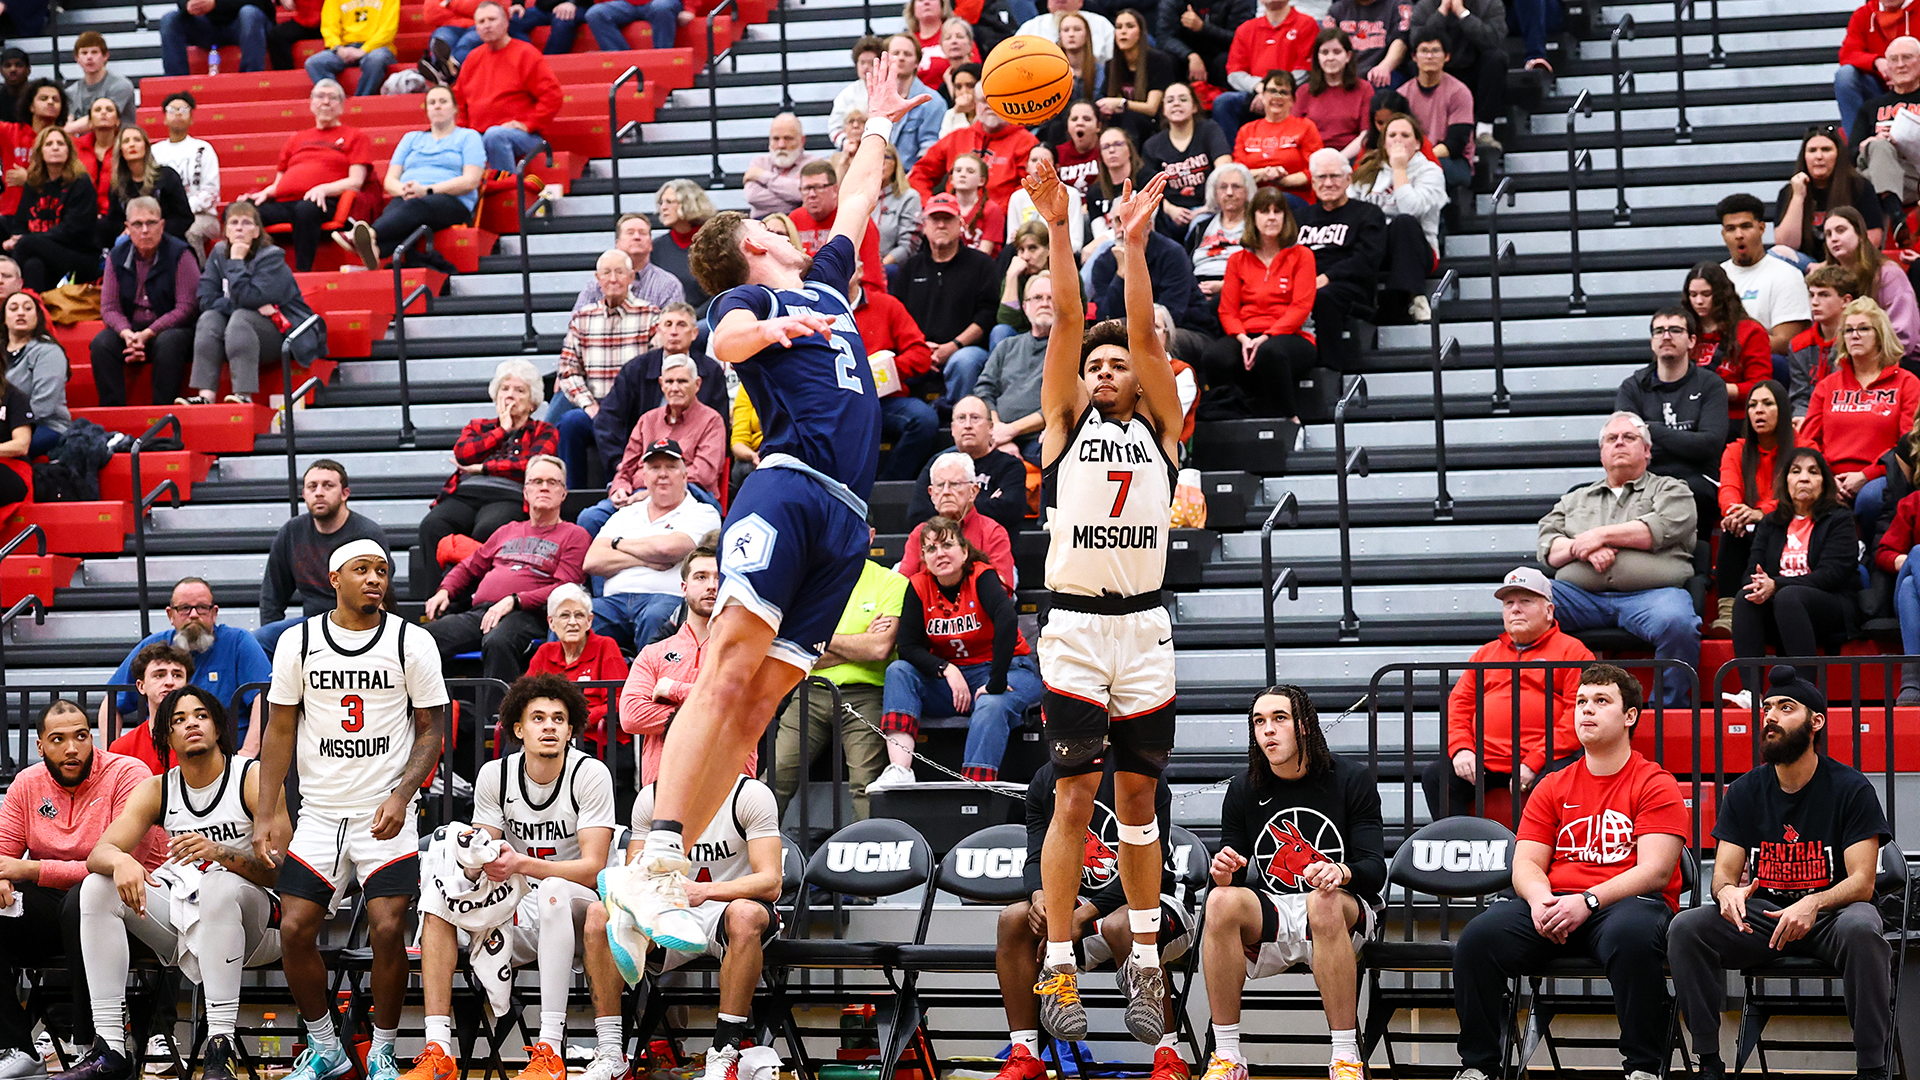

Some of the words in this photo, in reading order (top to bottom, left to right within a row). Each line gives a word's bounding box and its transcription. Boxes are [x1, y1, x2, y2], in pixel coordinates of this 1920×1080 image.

[1002, 92, 1062, 115] Wilson
[1057, 159, 1099, 181] ENTRA
[1297, 223, 1350, 246] CMSU
[829, 333, 864, 395] 2
[1832, 388, 1899, 405] UCM
[1831, 404, 1872, 413] MULES
[1079, 438, 1153, 465] CENTRAL
[1107, 470, 1133, 518] 7
[1072, 525, 1158, 549] MISSOURI
[926, 612, 982, 636] CENTRAL
[309, 670, 395, 690] CENTRAL
[340, 694, 364, 733] 3
[319, 735, 390, 758] MISSOURI
[171, 821, 246, 842] TRAL
[507, 819, 575, 841] CENTRAL
[826, 840, 915, 873] UCM
[1412, 839, 1509, 872] UCM
[1759, 840, 1825, 863] CENTRAL
[1757, 859, 1827, 882] MISSOURI
